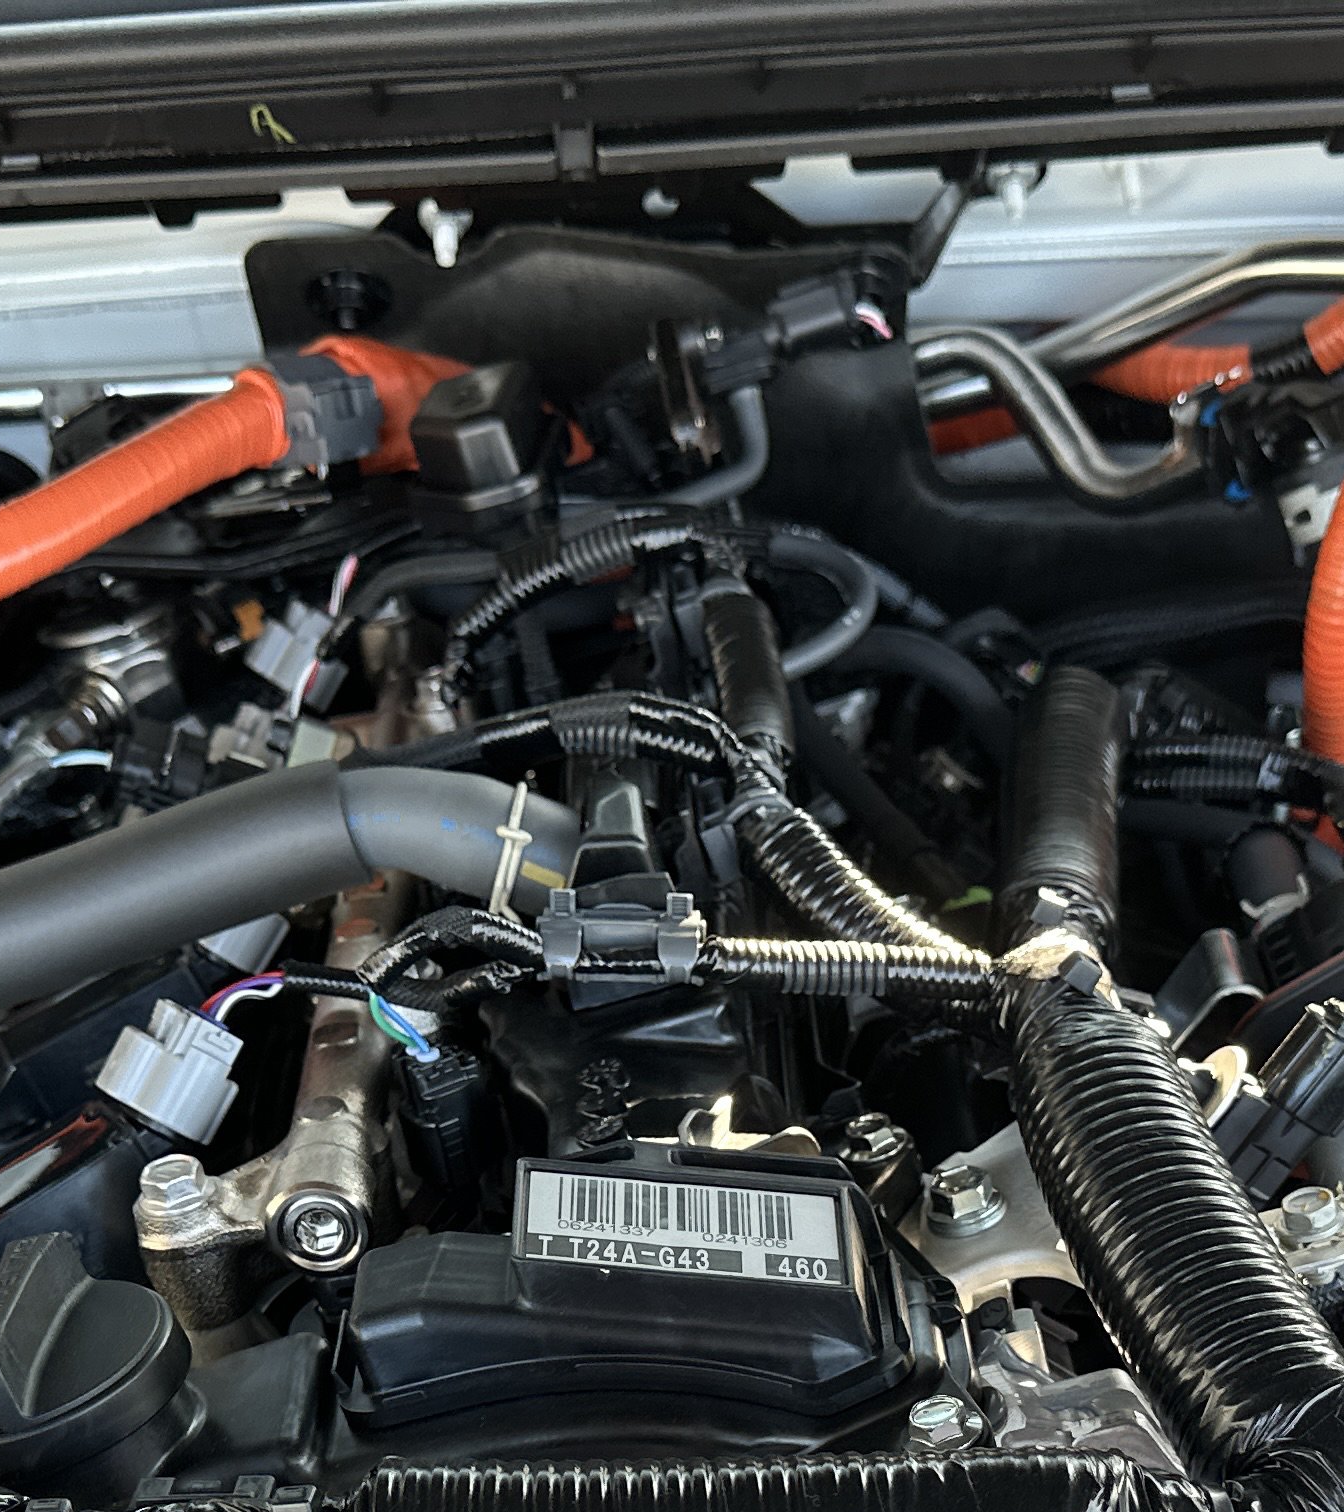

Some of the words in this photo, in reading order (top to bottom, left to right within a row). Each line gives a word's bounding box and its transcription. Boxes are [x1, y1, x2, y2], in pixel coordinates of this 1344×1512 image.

[557, 1219, 655, 1237] 06241337
[702, 1232, 788, 1249] 0241306
[538, 1235, 553, 1257] T
[569, 1237, 710, 1271] T24A-G43
[778, 1256, 828, 1281] 460
